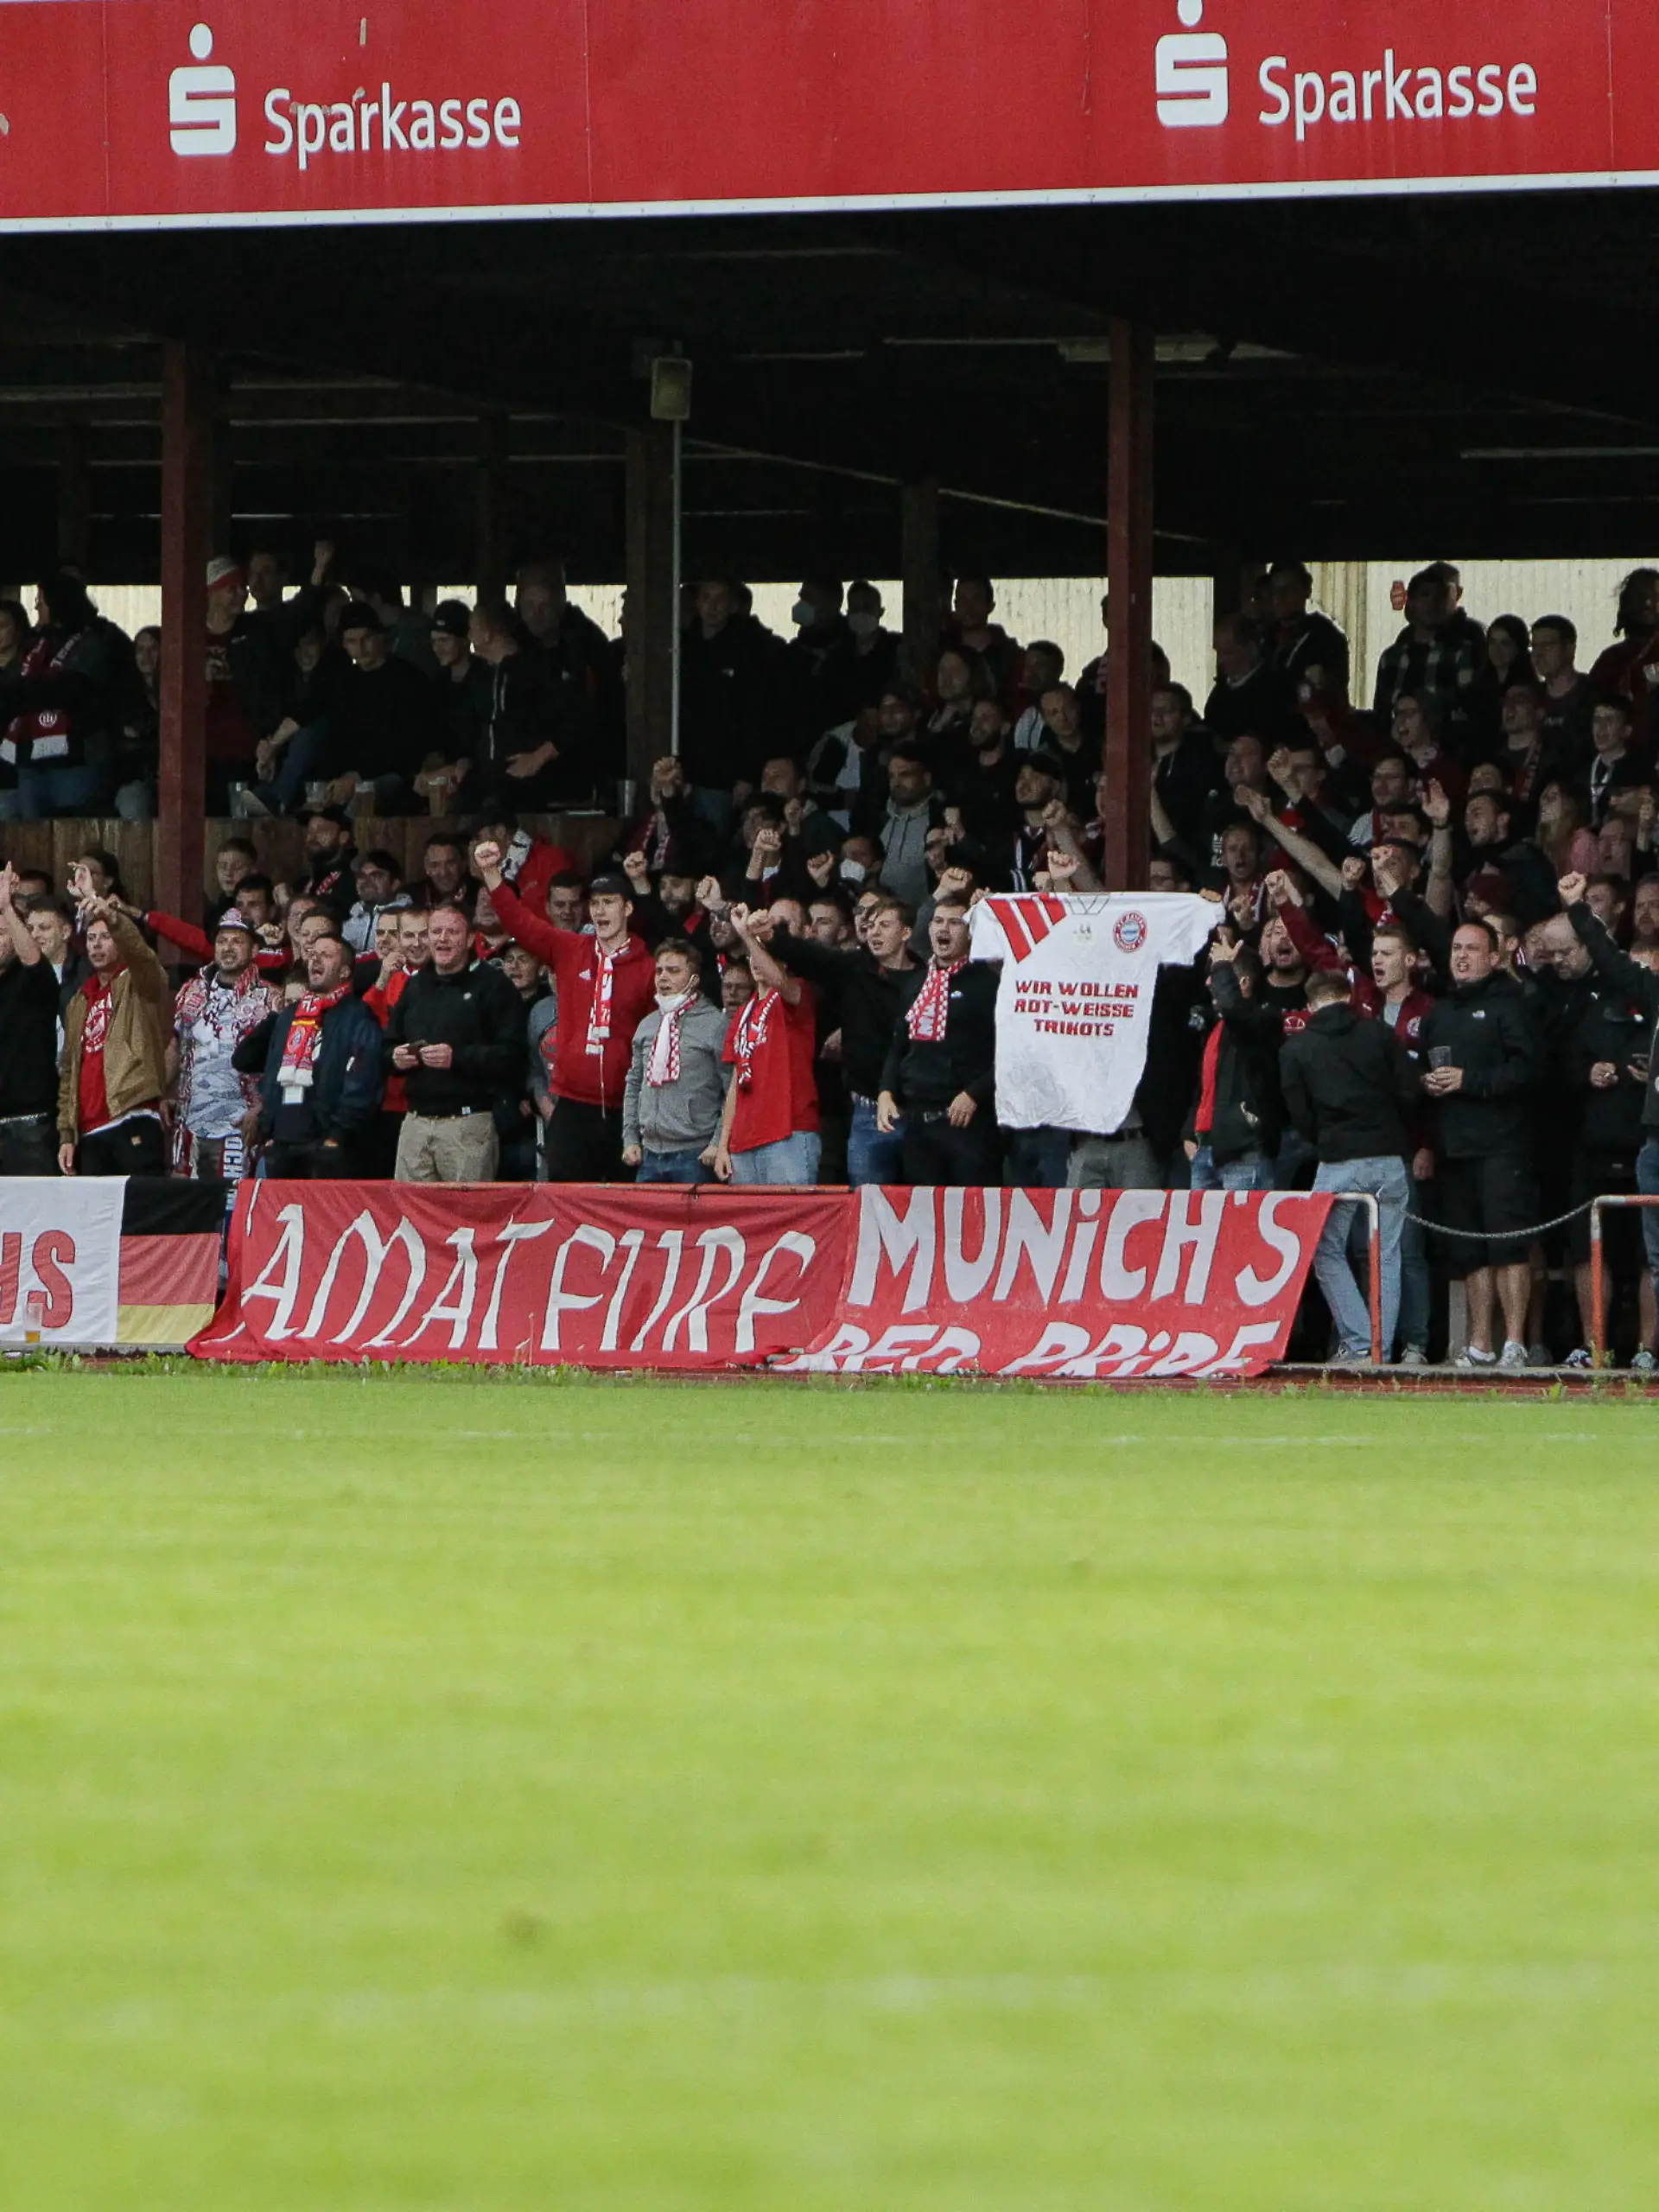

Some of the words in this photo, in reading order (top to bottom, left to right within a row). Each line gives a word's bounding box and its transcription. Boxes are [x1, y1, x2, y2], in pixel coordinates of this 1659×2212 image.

[1259, 48, 1538, 142] Sparkasse
[264, 82, 522, 171] Sparkasse
[1015, 980, 1052, 995] WIR
[1058, 982, 1140, 999] WOLLEN
[1014, 998, 1135, 1018] ROT-WEISSE
[1033, 1019, 1116, 1036] TRIKOTS
